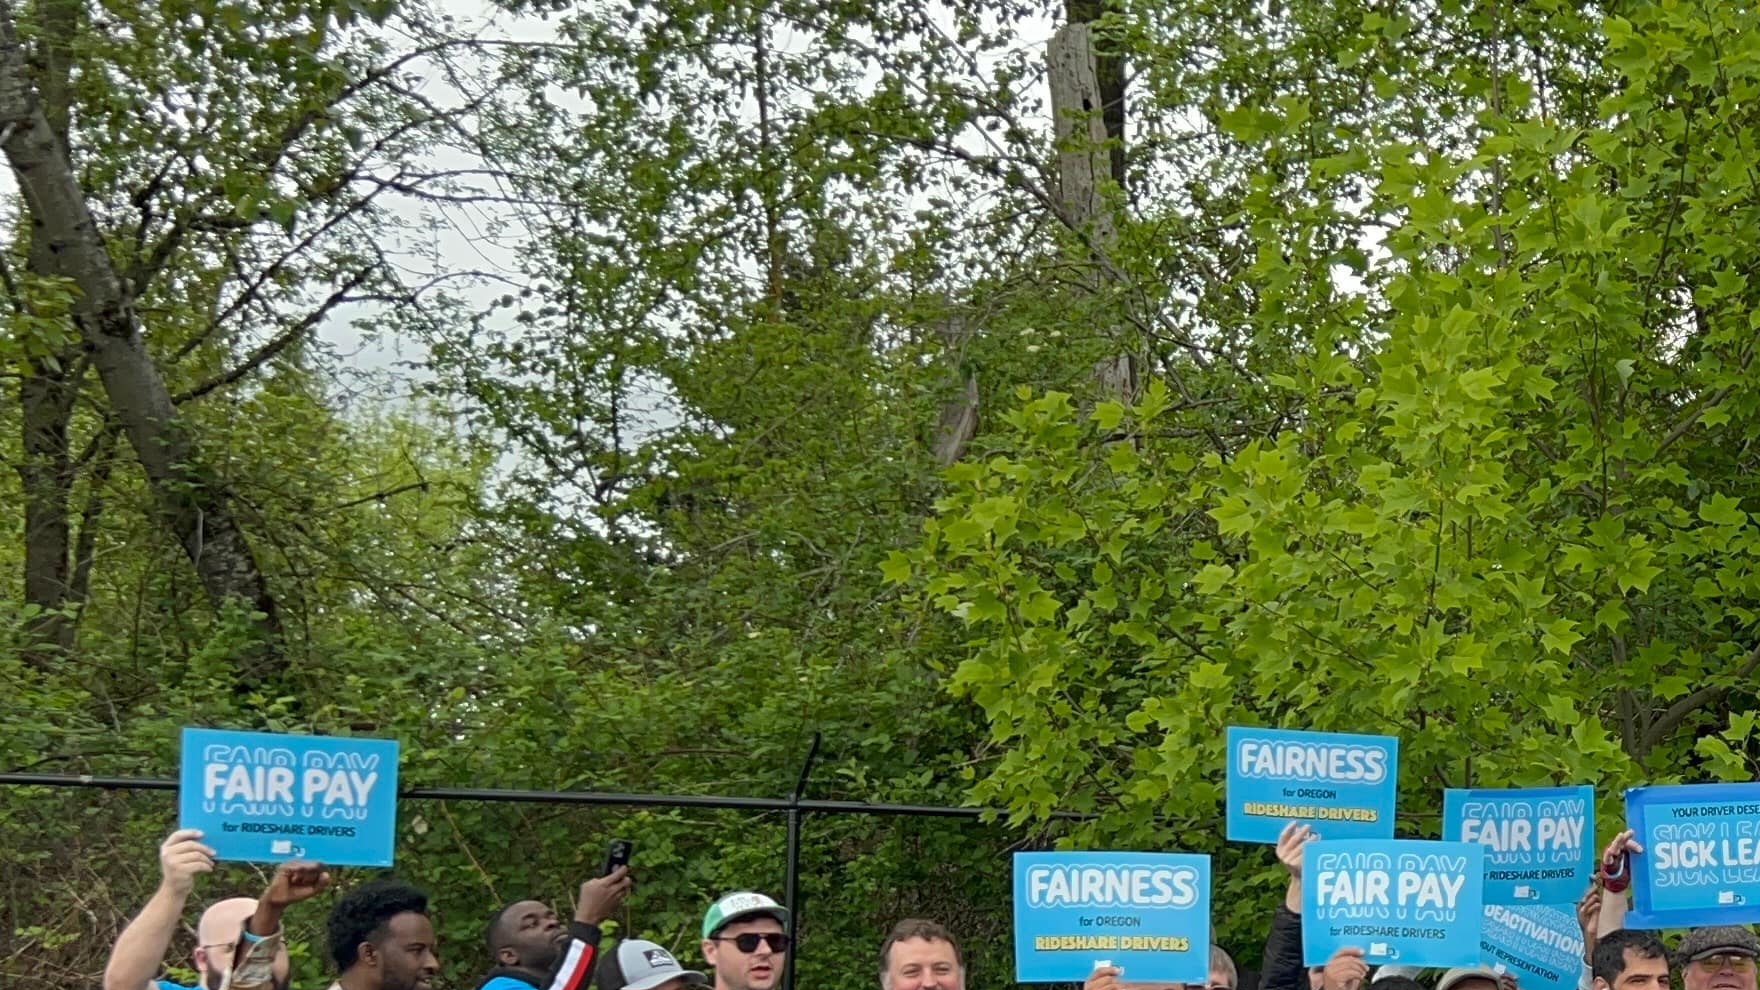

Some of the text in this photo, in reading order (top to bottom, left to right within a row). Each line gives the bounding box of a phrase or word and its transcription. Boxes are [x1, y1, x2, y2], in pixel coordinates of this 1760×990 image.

[1241, 743, 1384, 781] FAIRNESS
[204, 763, 378, 807] FAIR PAY
[1283, 787, 1336, 799] for OREGON
[1243, 802, 1377, 822] RIDESHARE DRIVERS
[1672, 807, 1698, 817] YOUR
[1701, 806, 1735, 816] DRIVER
[222, 822, 356, 837] for RIDESHARE DRIVERS
[1461, 816, 1584, 852] FAIR PAY
[1655, 839, 1718, 869] SICK
[1490, 869, 1539, 880] RIDESHARE
[1541, 867, 1575, 879] DRIVERS
[1031, 868, 1195, 905] FAIRNESS
[1317, 870, 1465, 909] FAIR PAY
[1079, 916, 1140, 927] for OREGON
[1484, 904, 1584, 957] DEACTIVATION
[1330, 925, 1446, 939] for RIDESHARE DRIVERS
[1035, 935, 1189, 952] RIDESHARE DRIVERS
